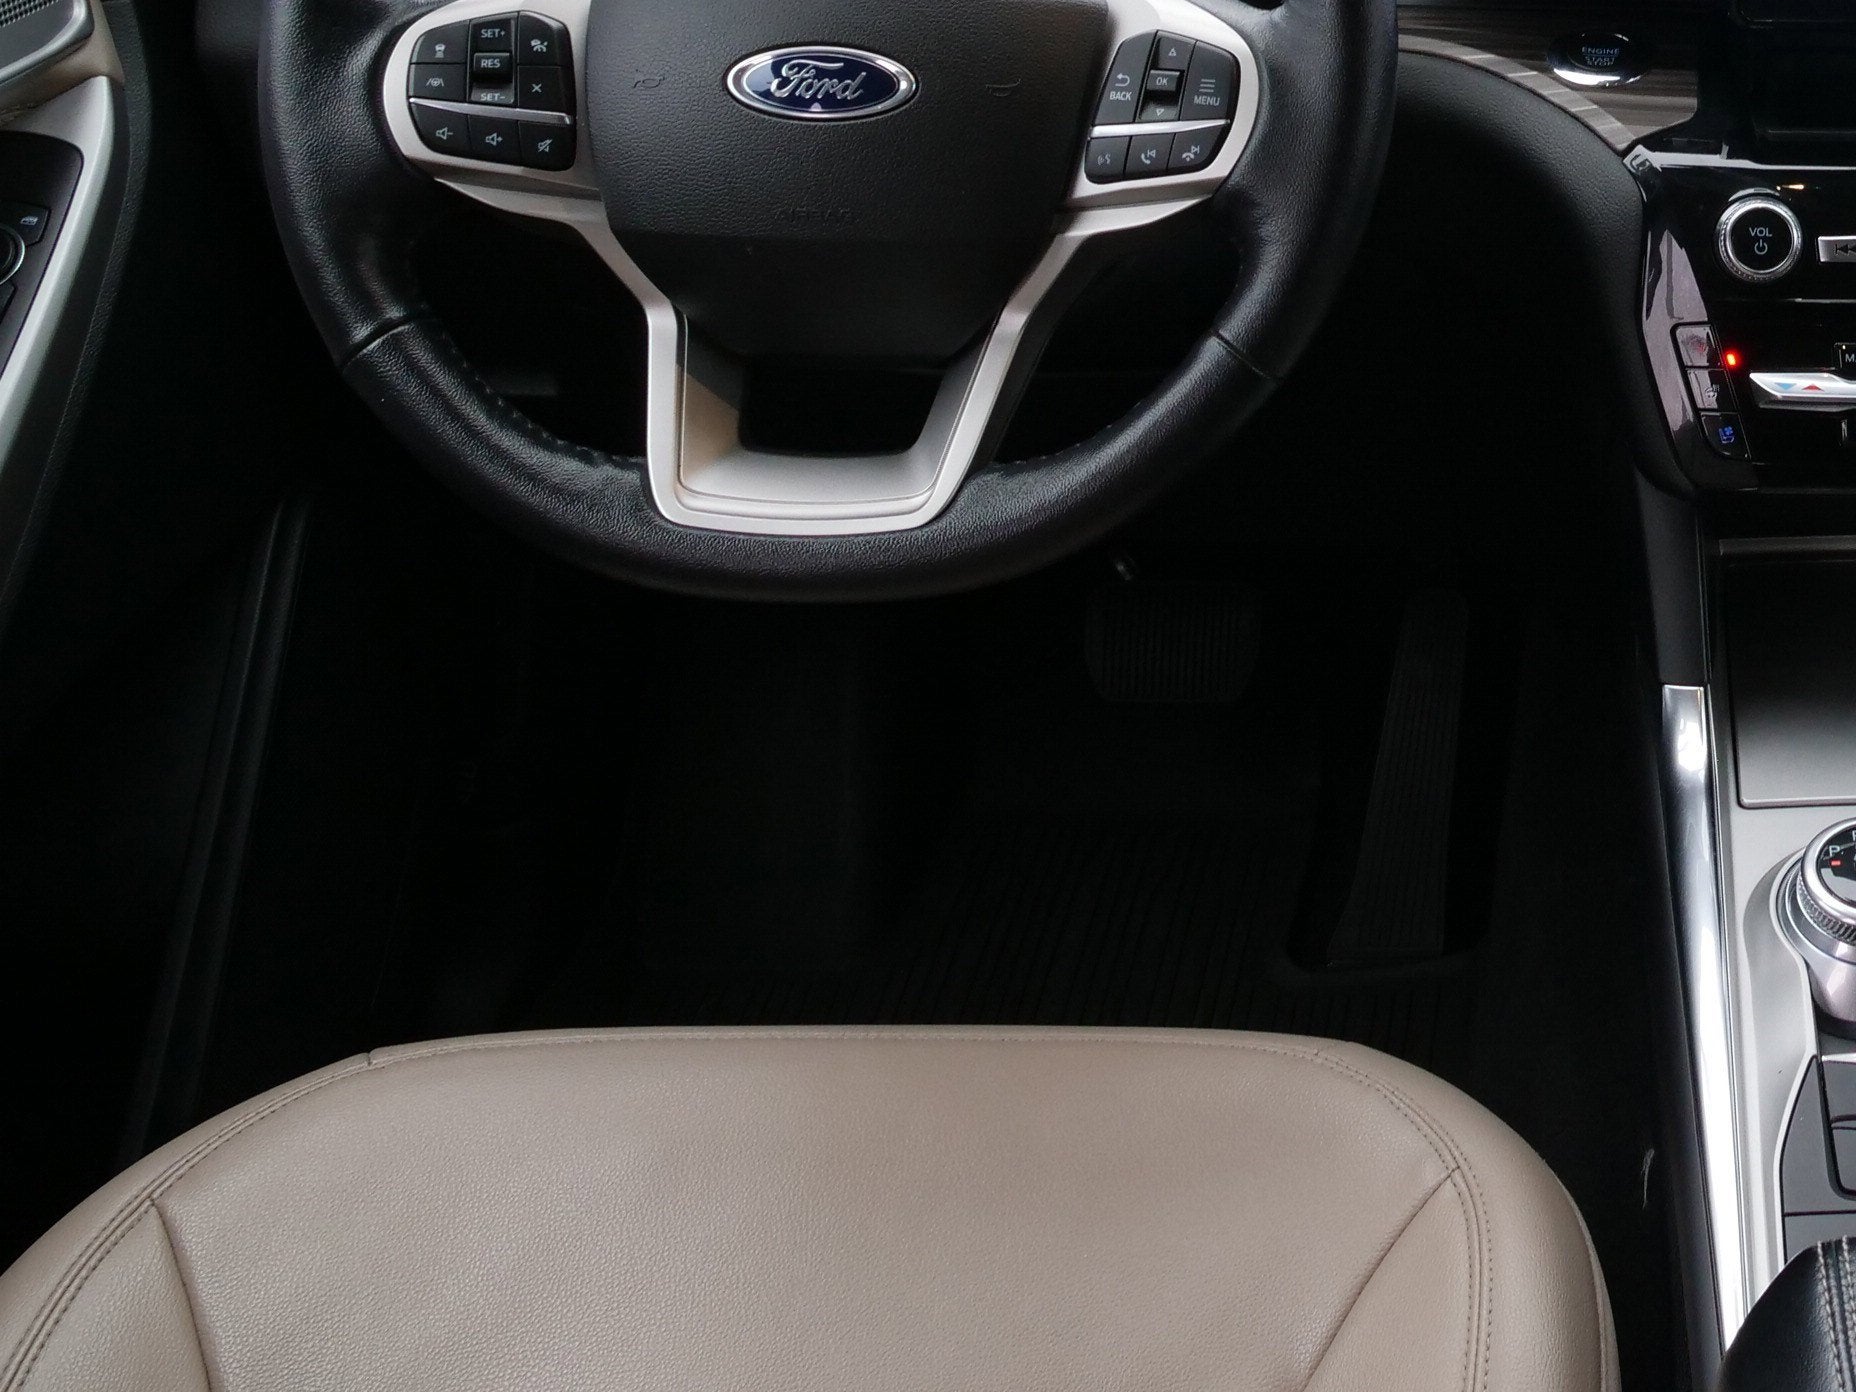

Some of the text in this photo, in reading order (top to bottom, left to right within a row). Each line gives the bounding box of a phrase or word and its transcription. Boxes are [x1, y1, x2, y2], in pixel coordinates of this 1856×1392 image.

[1582, 46, 1619, 55] ENGINE
[481, 59, 500, 68] RES
[770, 59, 867, 100] Ford
[1156, 77, 1168, 85] OK
[1109, 92, 1132, 101] BACK
[1193, 95, 1221, 106] MENU
[1749, 227, 1773, 238] VOL
[1828, 845, 1840, 857] P
